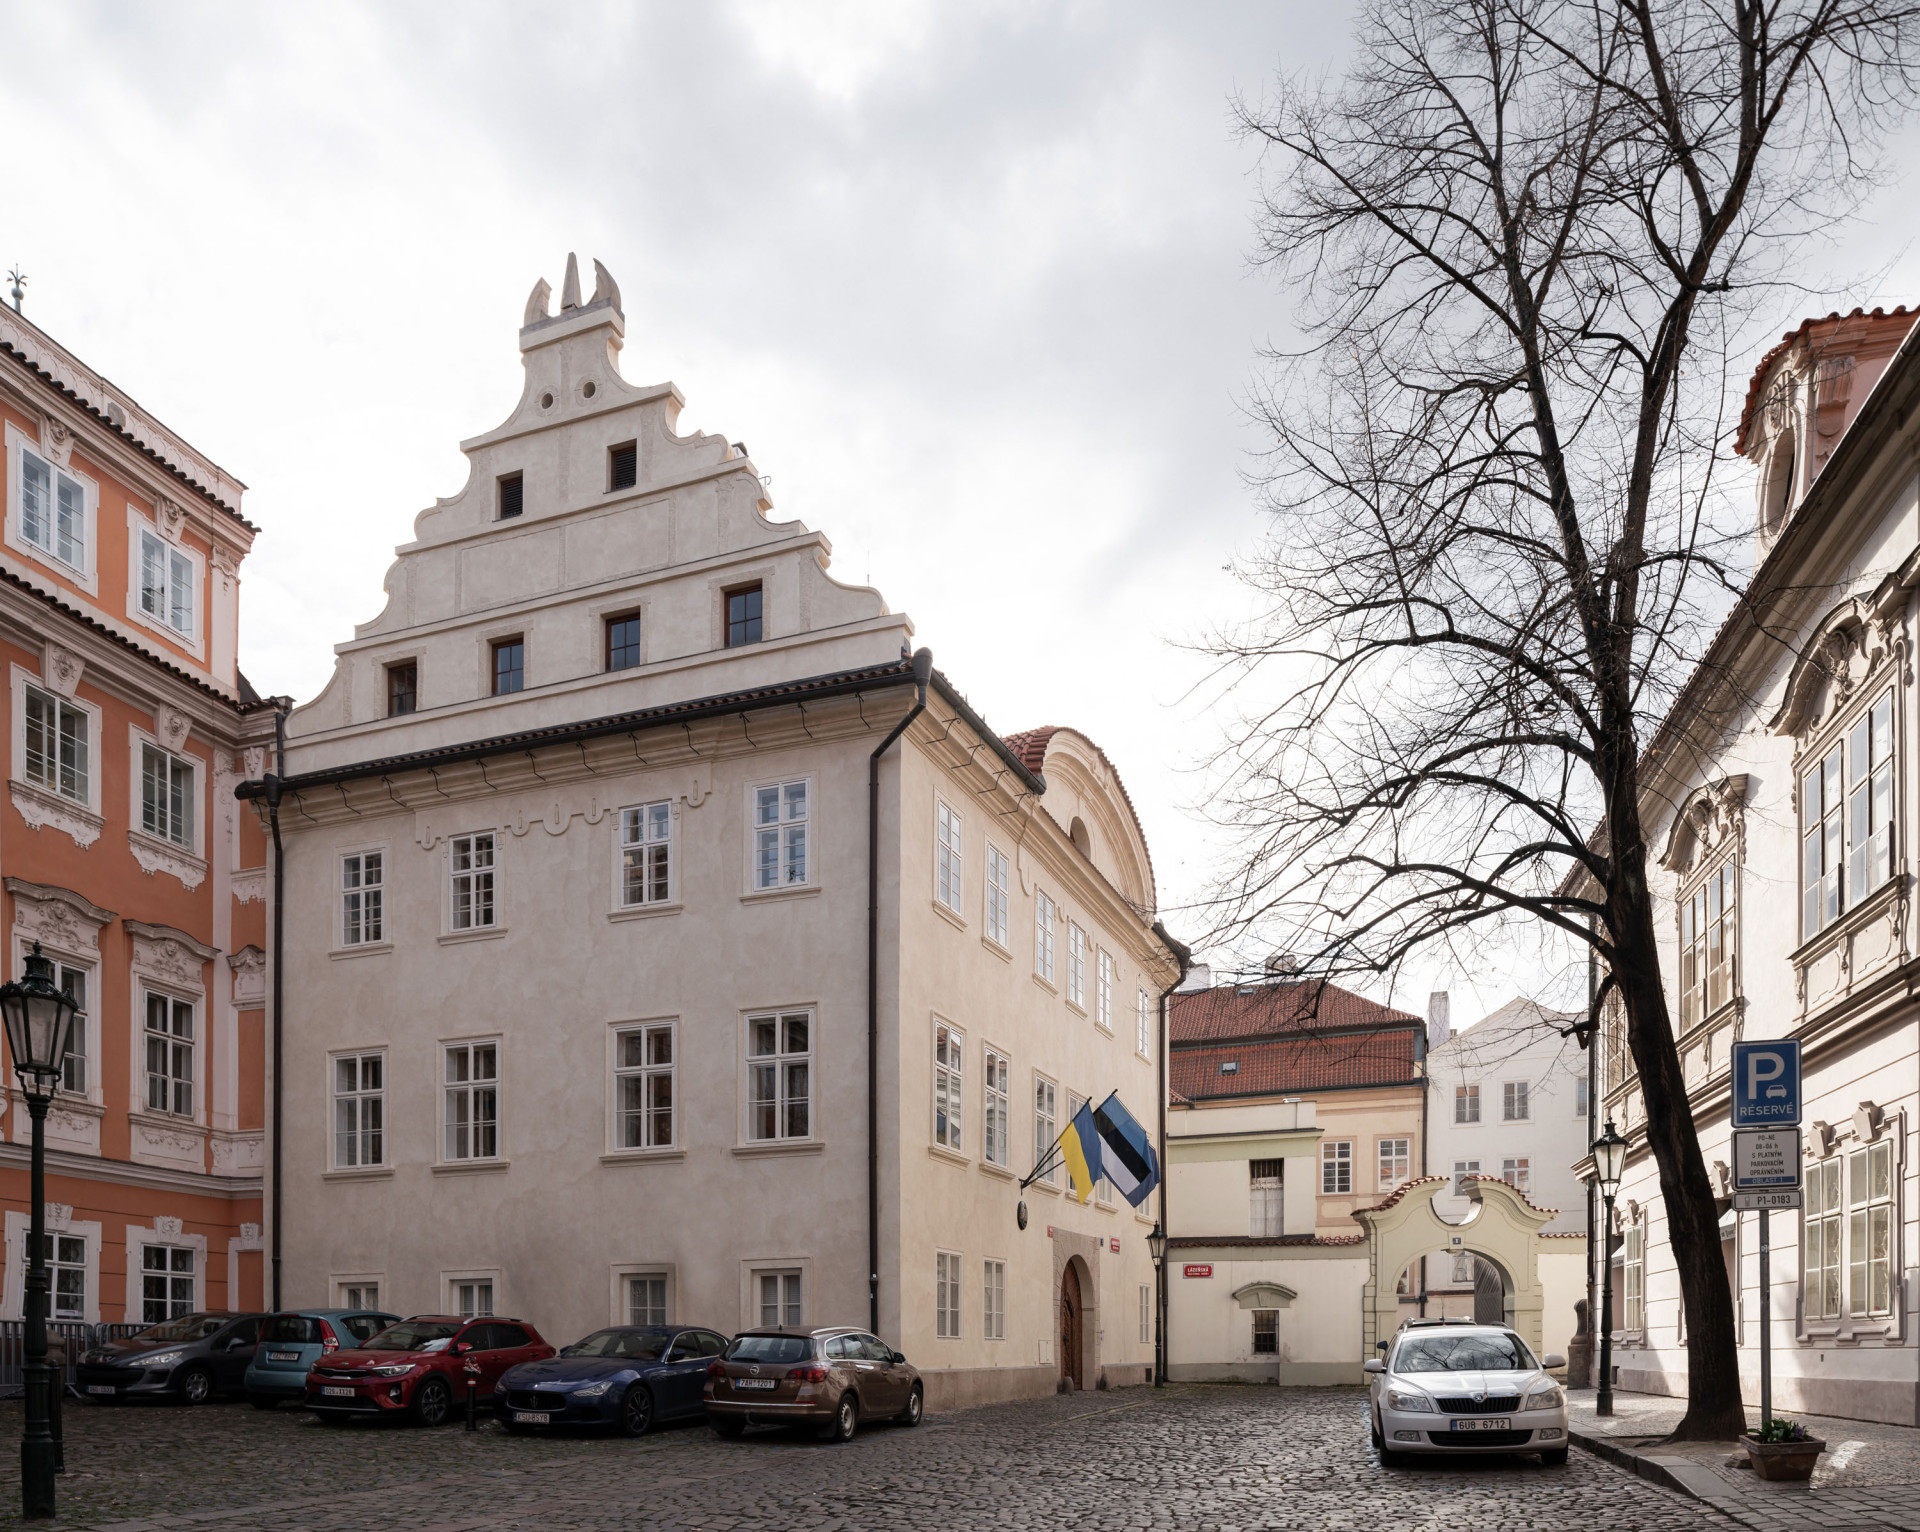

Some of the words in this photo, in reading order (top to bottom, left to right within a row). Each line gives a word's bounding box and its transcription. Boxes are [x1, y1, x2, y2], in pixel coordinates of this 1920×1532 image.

[1747, 1052, 1785, 1100] P
[1740, 1102, 1794, 1117] RÉSERVÉ
[1757, 1150, 1782, 1158] PLATNÝM
[1750, 1159, 1784, 1167] PARKOVACÍM
[1750, 1167, 1785, 1176] OPRÁVNĚNÍM
[1757, 1195, 1791, 1205] P1-0183
[1459, 1421, 1476, 1430] 6U8
[1482, 1420, 1506, 1429] 6712
